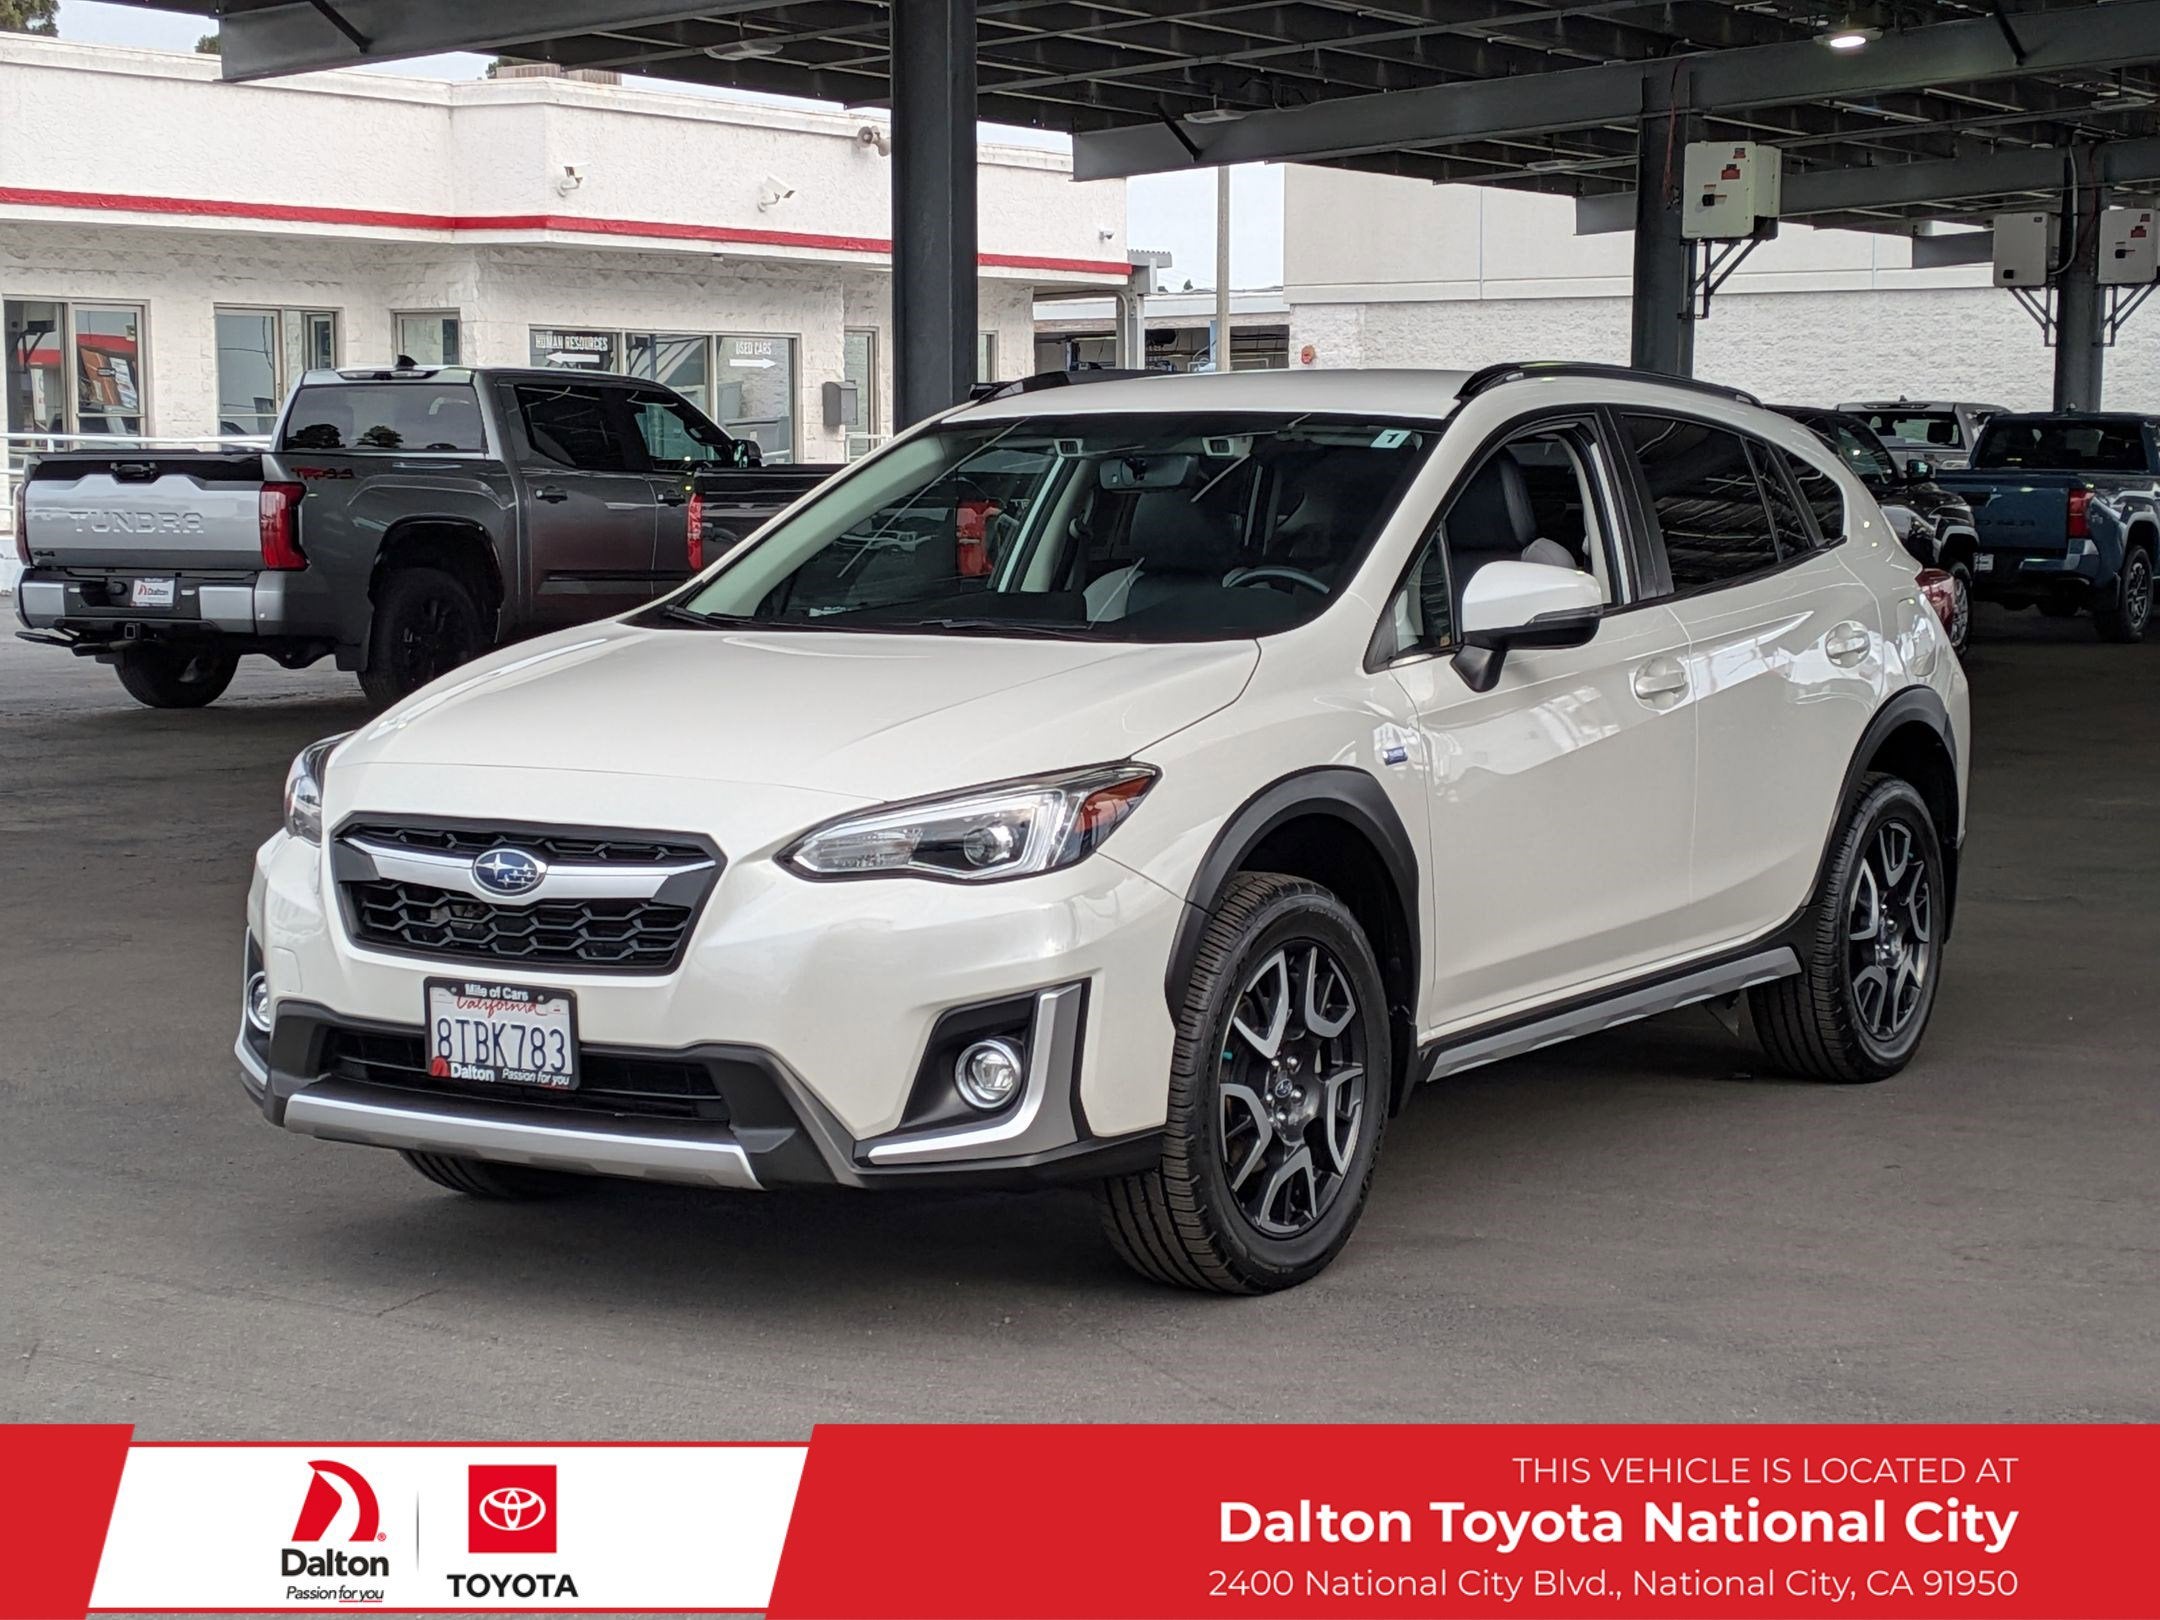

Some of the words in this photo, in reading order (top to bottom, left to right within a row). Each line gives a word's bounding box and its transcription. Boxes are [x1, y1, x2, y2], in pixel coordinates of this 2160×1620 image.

[535, 335, 564, 349] HUMAN
[564, 336, 608, 351] RESOURCES
[735, 341, 753, 355] USED
[754, 341, 772, 355] CARS
[68, 510, 204, 534] TUNDRA
[465, 984, 488, 997] Mile
[489, 985, 500, 998] of
[502, 987, 529, 1001] Cars
[456, 995, 547, 1018] California
[437, 1018, 565, 1072] 8TBK783
[451, 1063, 495, 1082] Dalton
[502, 1068, 536, 1082] Passion
[536, 1071, 551, 1084] for
[551, 1075, 570, 1086] you
